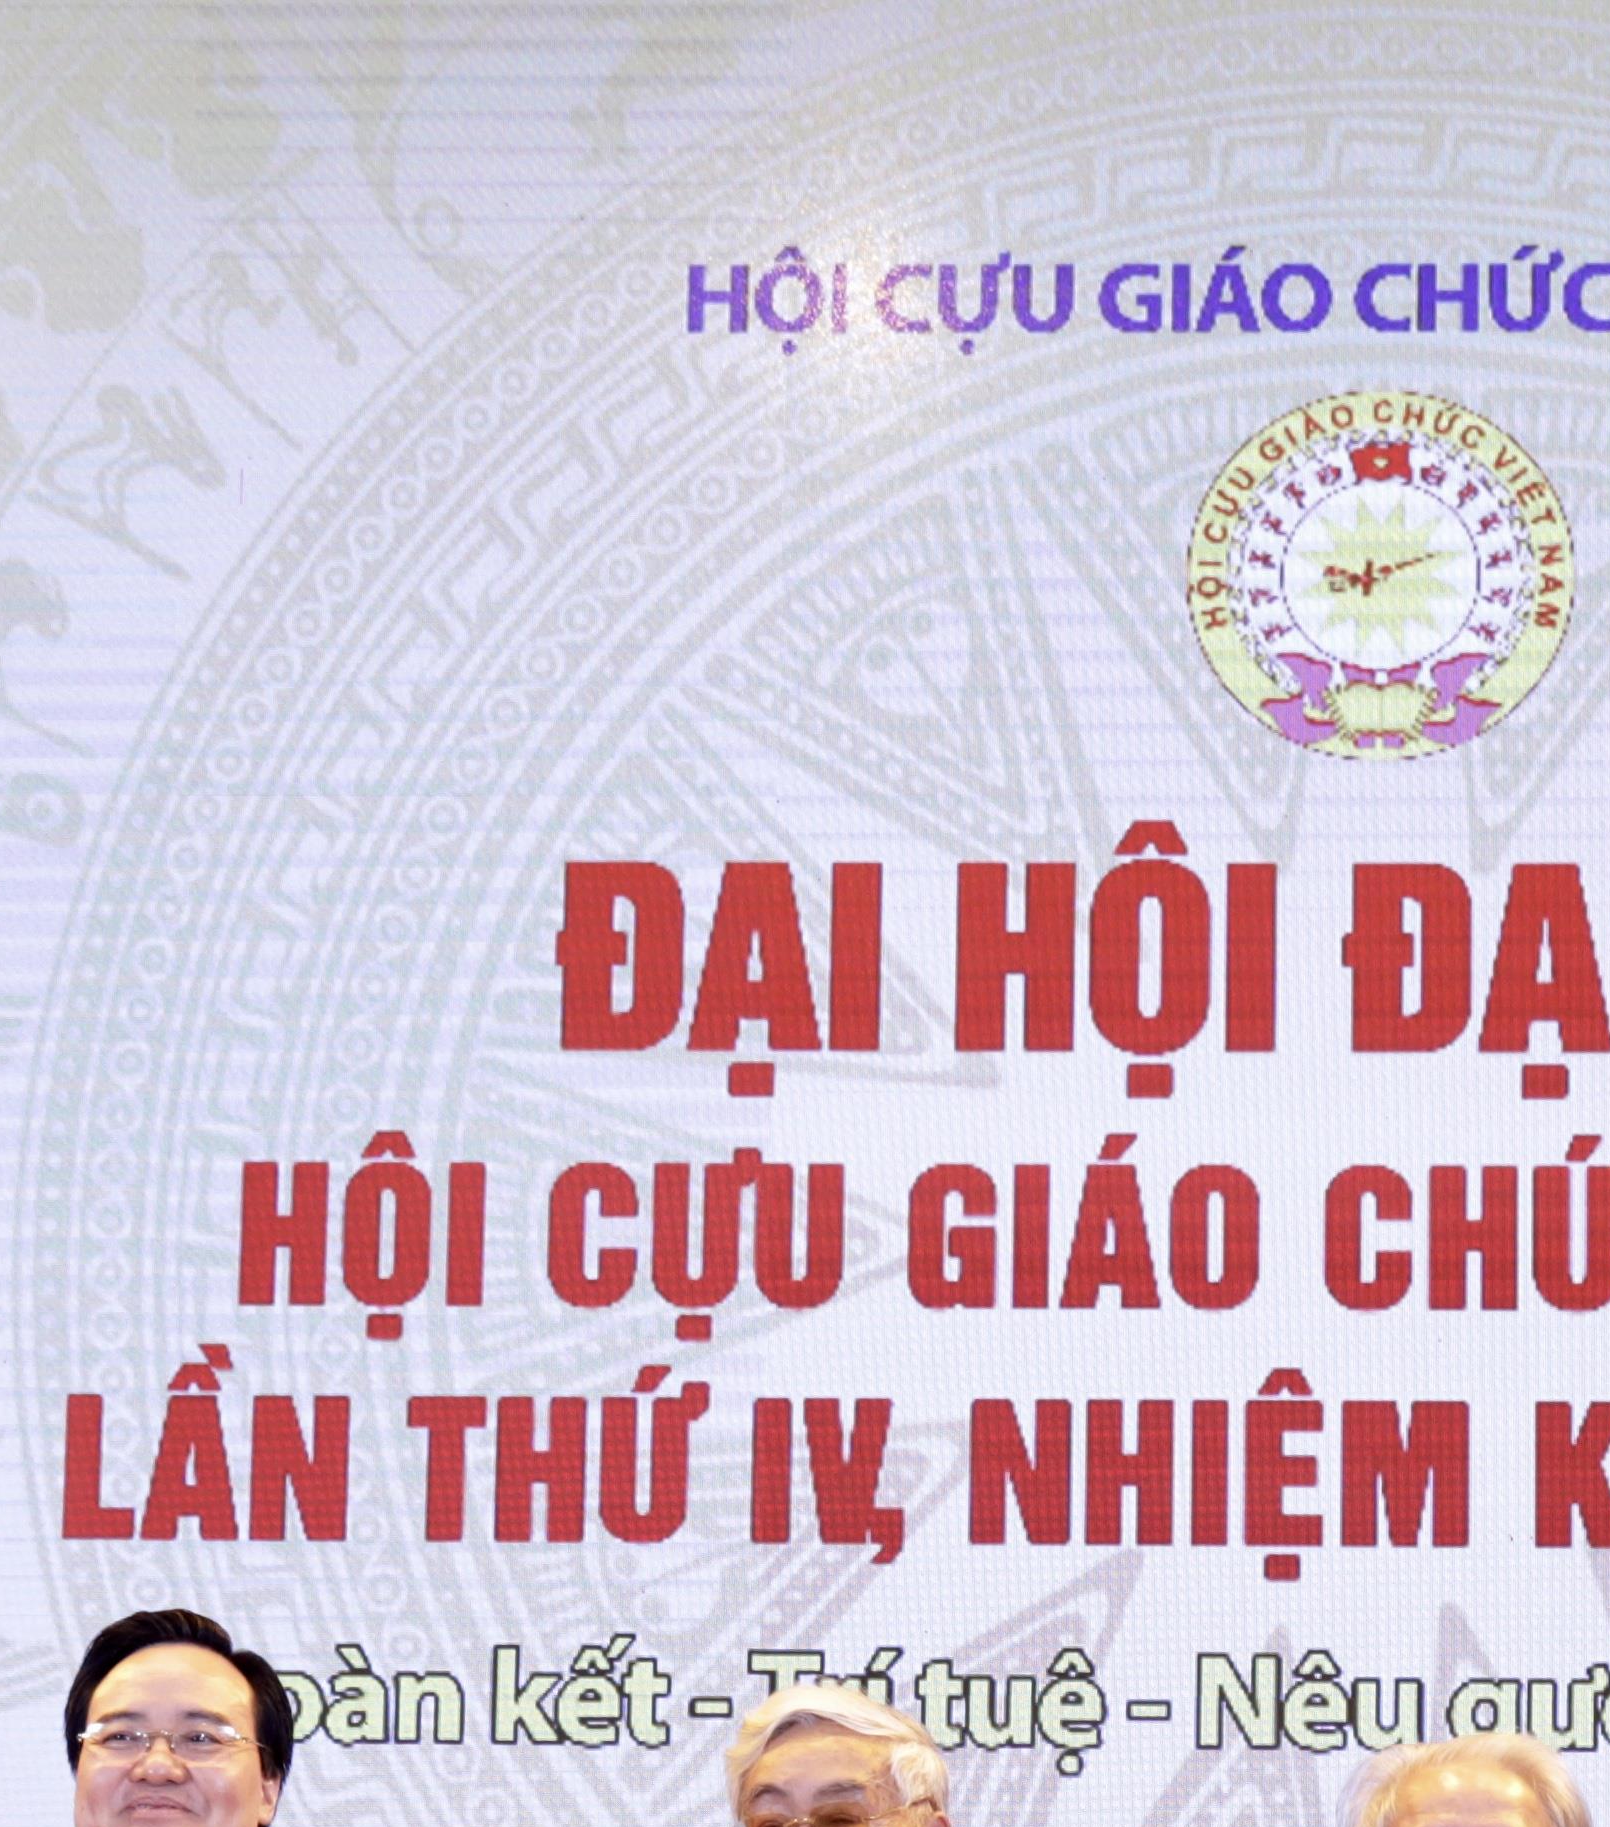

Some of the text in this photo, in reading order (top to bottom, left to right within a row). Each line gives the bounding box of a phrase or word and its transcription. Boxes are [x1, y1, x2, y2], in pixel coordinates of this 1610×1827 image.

[688, 246, 847, 355] HỘI
[877, 250, 1076, 355] CỰU
[1096, 246, 1335, 335] GIÁO
[555, 860, 881, 1098] ĐẠI
[956, 819, 1277, 1099] HỘI
[239, 1131, 486, 1341] HỘI
[548, 1148, 844, 1341] CỰU
[908, 1134, 1260, 1310] GIÁO
[62, 1344, 350, 1542] LẦN
[407, 1365, 711, 1543] THỨ
[751, 1398, 904, 1563] IV,
[970, 1369, 1469, 1580] NHIỆM
[276, 1643, 465, 1747] oàn
[491, 1633, 672, 1748] kết
[914, 1647, 1107, 1777] tuệ
[1196, 1650, 1424, 1752] Nêu
